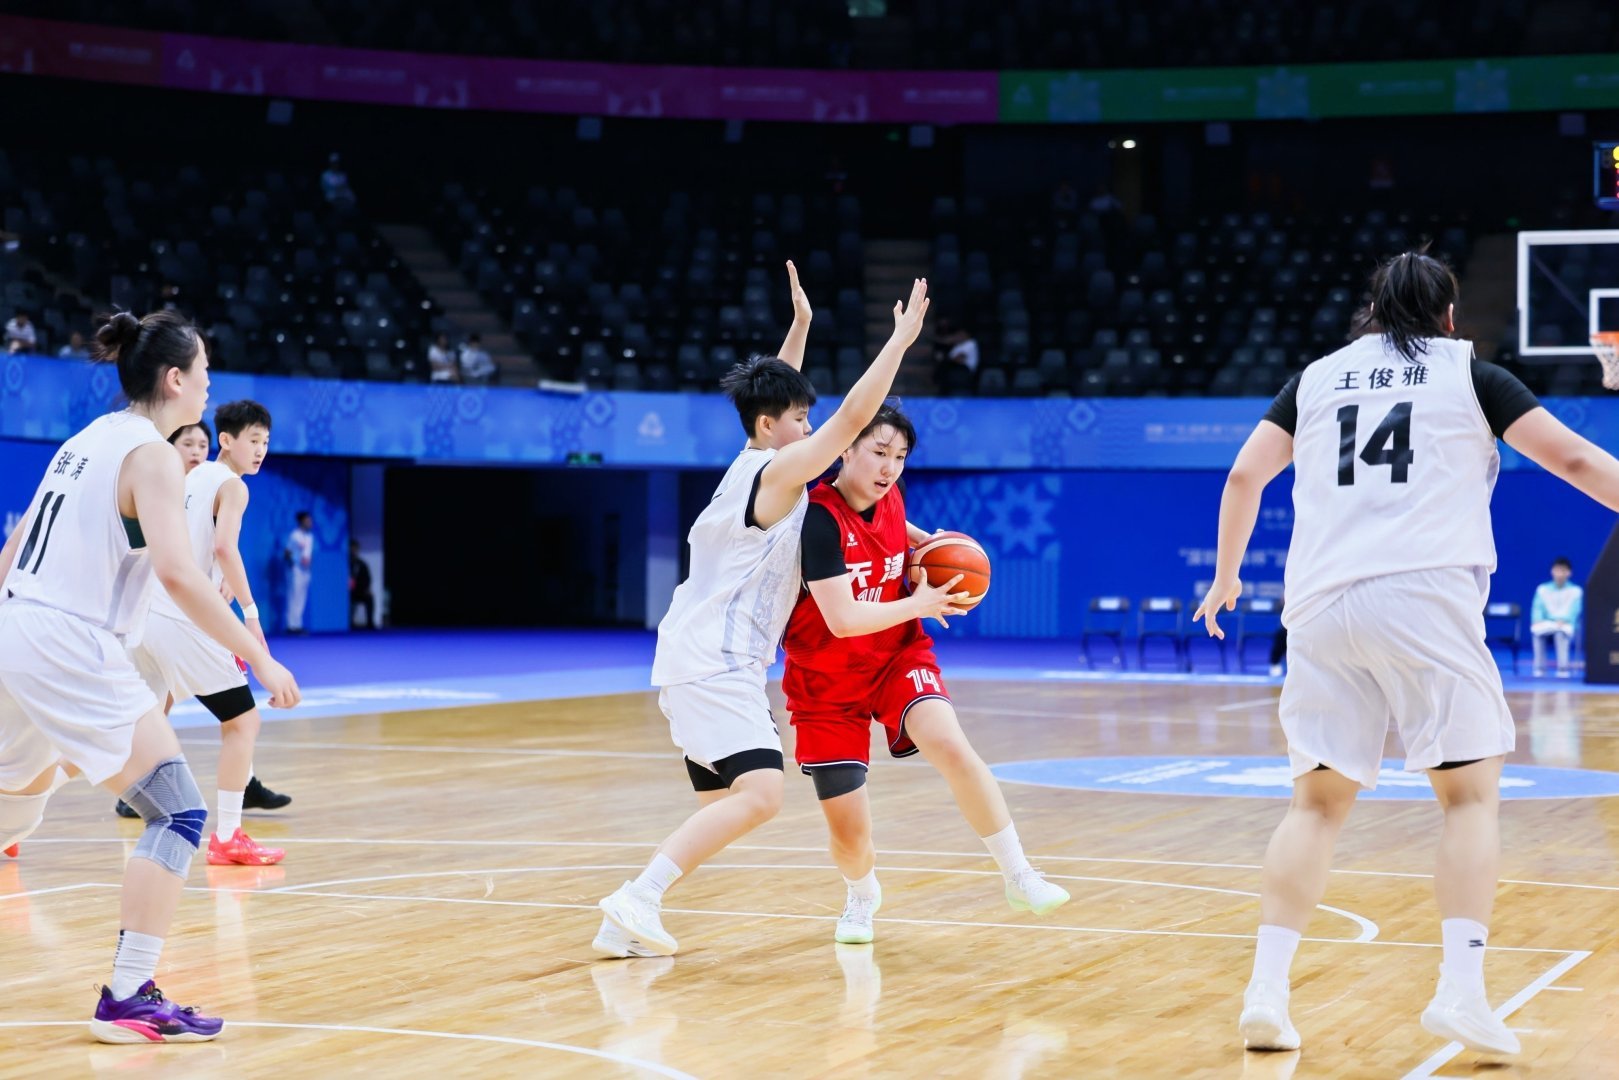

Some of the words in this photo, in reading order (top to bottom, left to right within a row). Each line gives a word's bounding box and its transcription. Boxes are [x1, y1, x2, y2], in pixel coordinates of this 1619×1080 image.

[1334, 365, 1429, 390] 王俊雅
[1336, 401, 1414, 487] 14
[54, 451, 89, 480] 张涛
[17, 490, 66, 575] 11
[845, 551, 905, 588] 天津
[905, 668, 941, 693] 14
